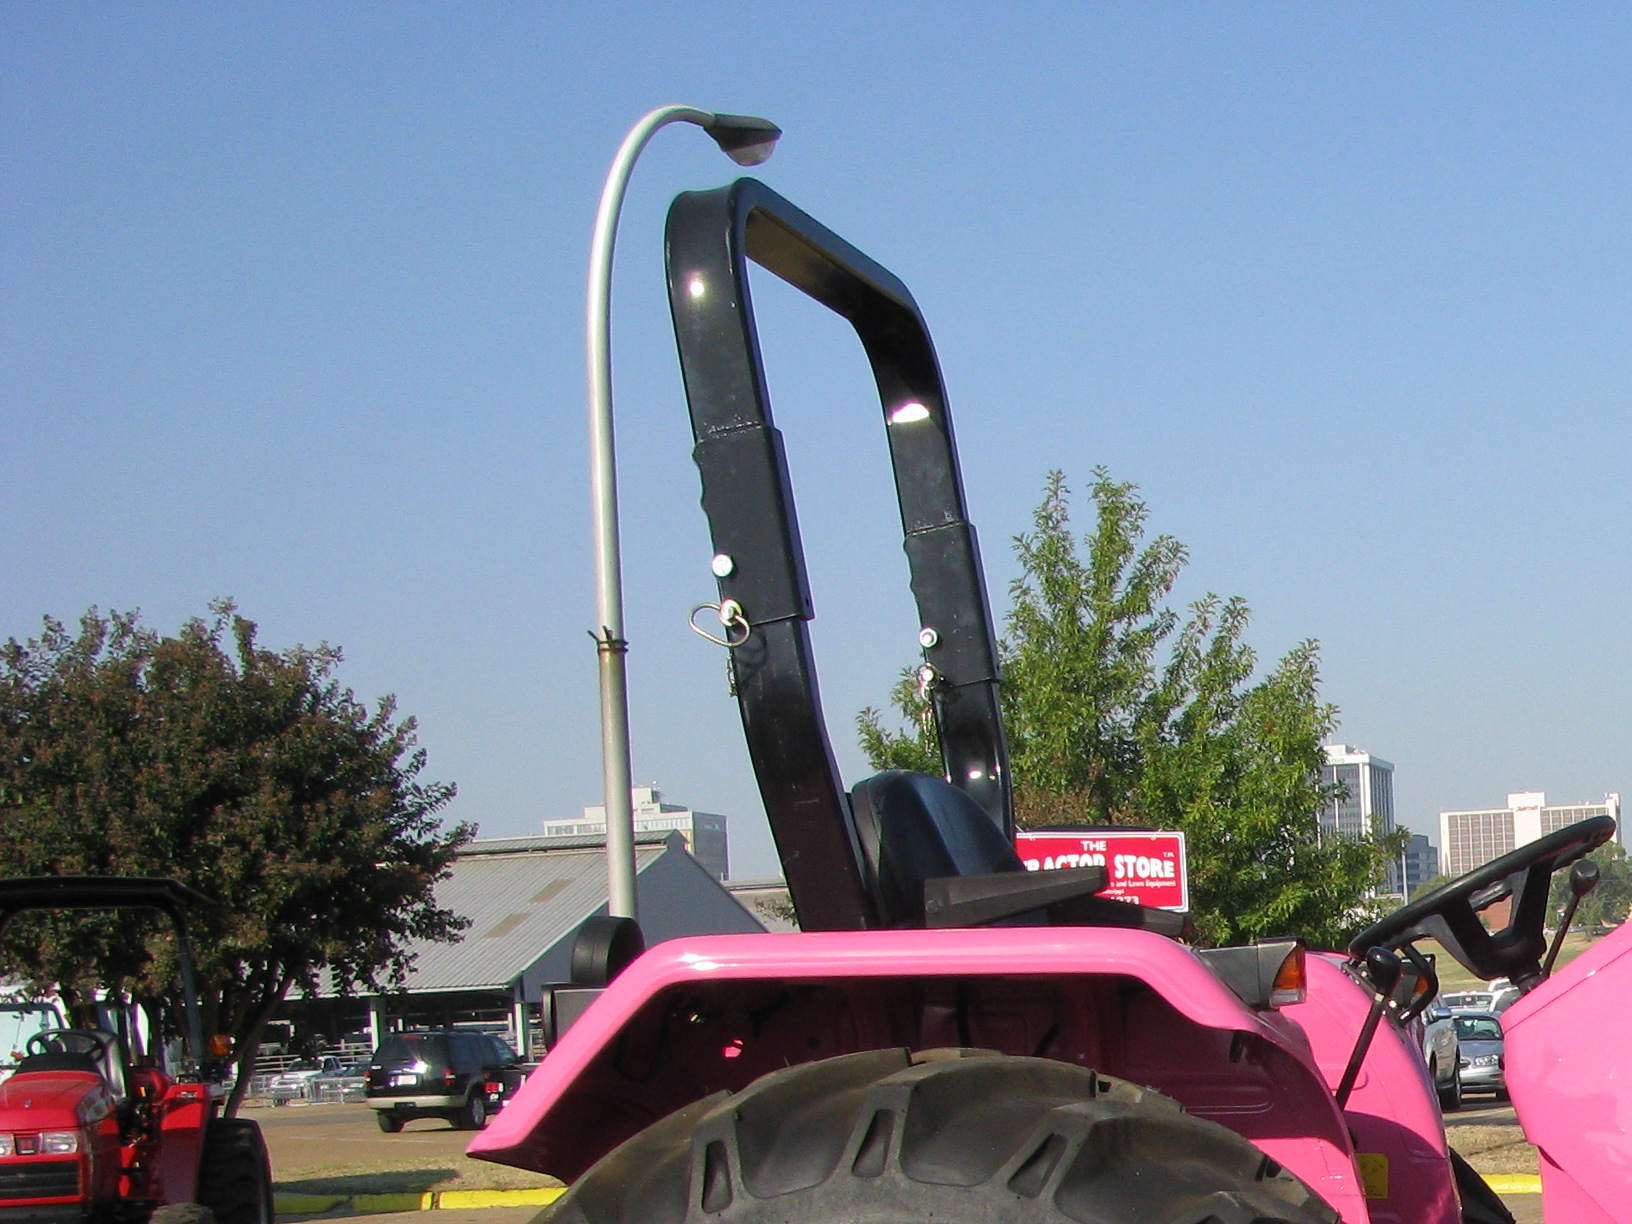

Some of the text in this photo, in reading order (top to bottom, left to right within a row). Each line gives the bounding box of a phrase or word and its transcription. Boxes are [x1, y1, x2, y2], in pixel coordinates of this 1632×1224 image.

[1080, 840, 1107, 852] THE
[1114, 853, 1175, 879] STORE
[1128, 880, 1144, 888] Lawn
[1145, 879, 1177, 889] Equipment
